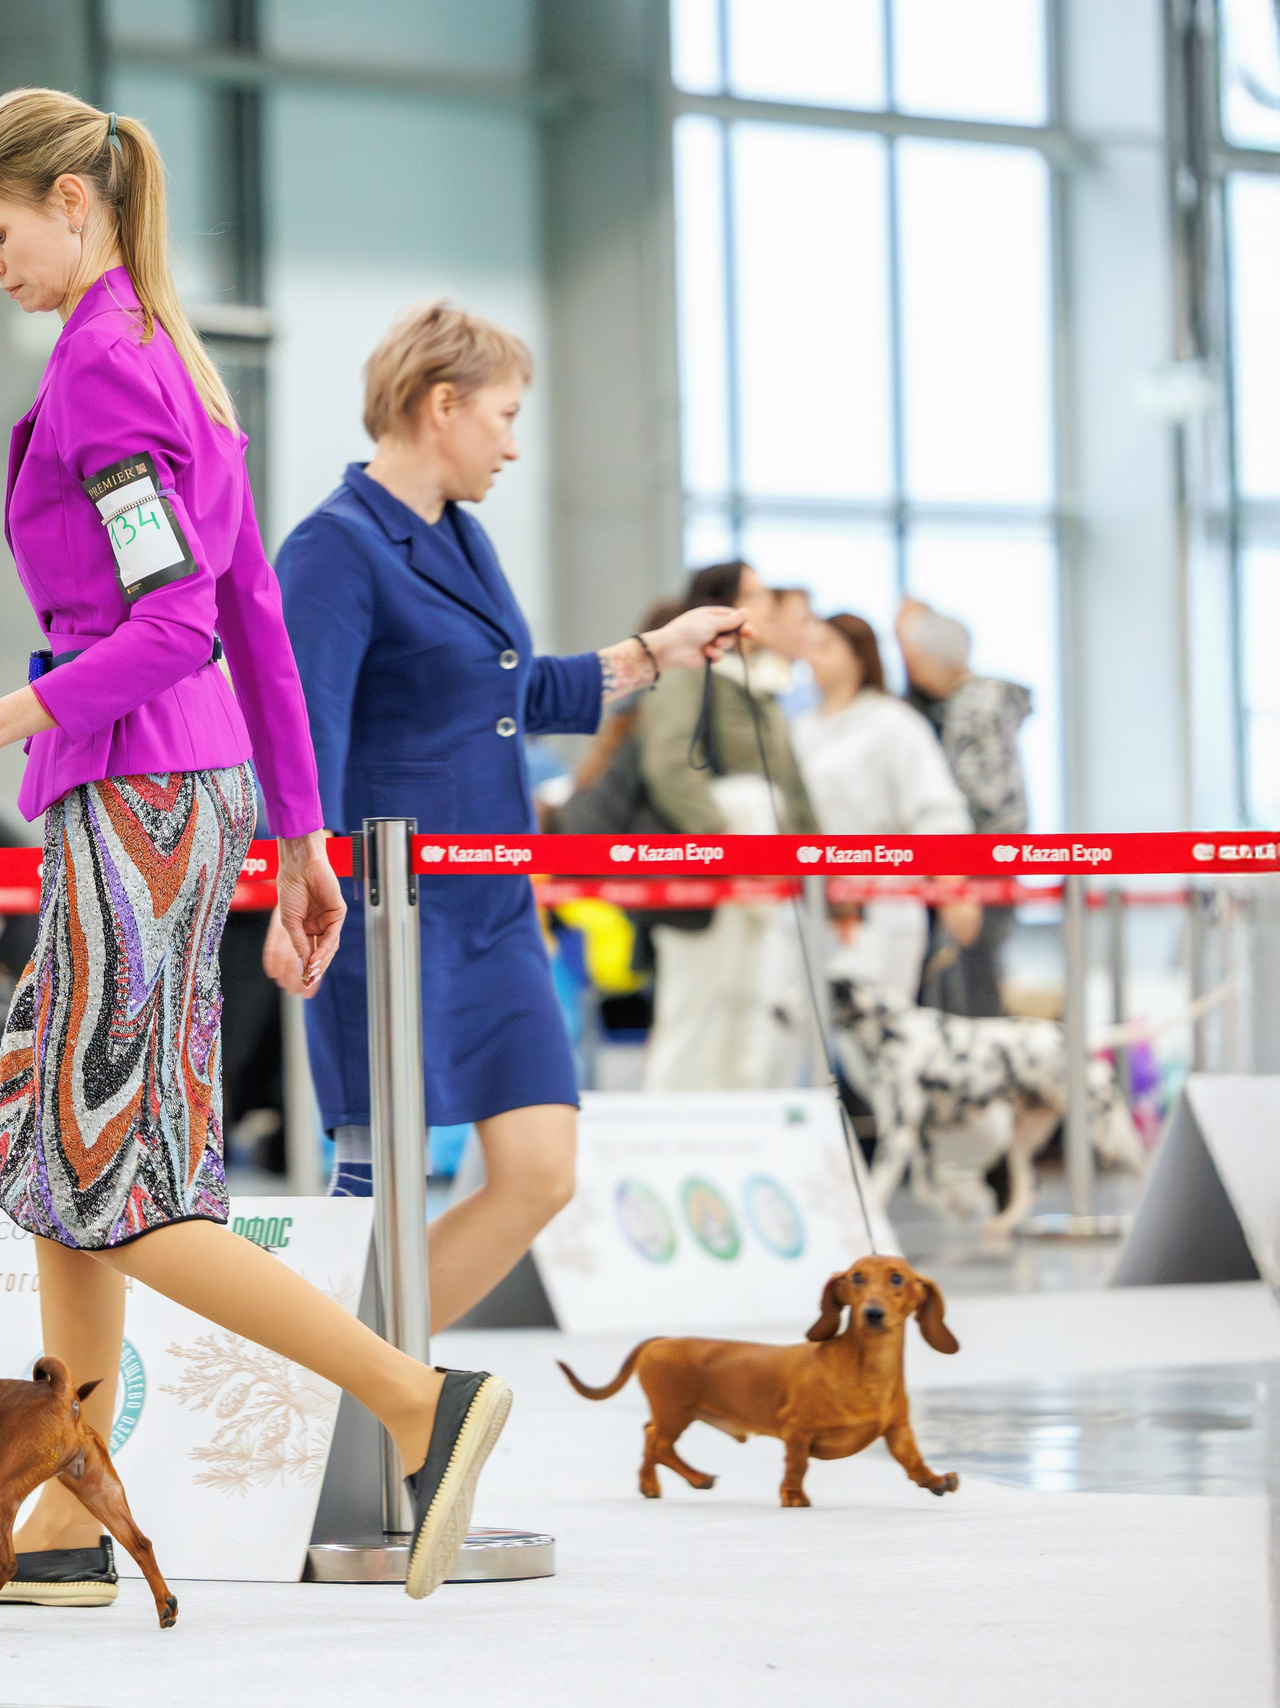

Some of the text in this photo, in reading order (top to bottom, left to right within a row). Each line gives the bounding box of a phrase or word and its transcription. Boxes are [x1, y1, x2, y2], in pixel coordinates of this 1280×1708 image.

[88, 467, 136, 499] PREMIER
[111, 504, 161, 550] 134
[448, 845, 532, 866] Kazan Expo
[638, 843, 723, 864] Kazan Expo
[826, 845, 913, 866] Kazan Expo
[1022, 844, 1112, 866] Kazan Expo
[241, 858, 268, 876] xpo
[121, 1342, 145, 1410] ЛЕЩЕЕВО
